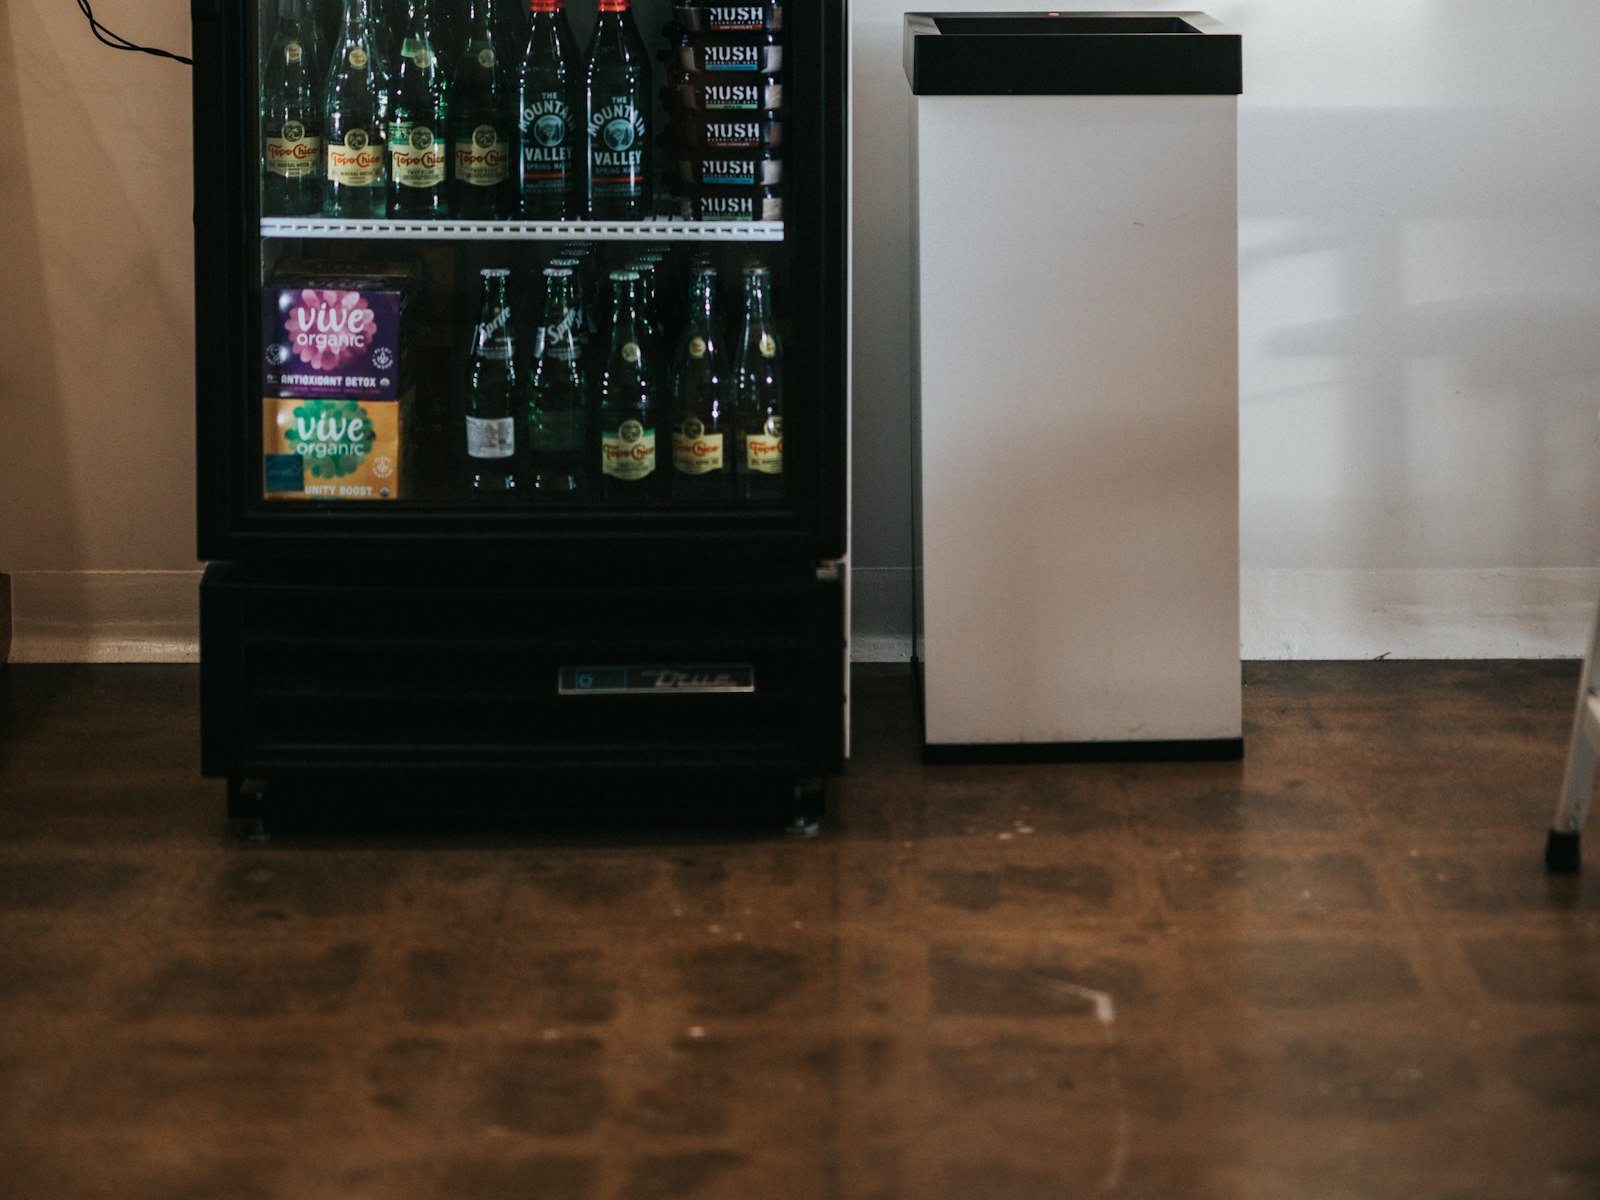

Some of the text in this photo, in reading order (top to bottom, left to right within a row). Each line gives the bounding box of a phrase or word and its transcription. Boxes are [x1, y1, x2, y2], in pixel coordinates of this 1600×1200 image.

[710, 7, 763, 21] MUSH
[705, 46, 758, 61] MUSH
[542, 92, 557, 100] THE
[612, 96, 628, 104] THE
[705, 85, 758, 100] MUSH
[587, 104, 646, 137] MOUNTAIN
[706, 123, 760, 138] MUSH
[269, 144, 318, 159] Topo Chico
[456, 150, 485, 166] Topo
[525, 147, 573, 161] VALLEY
[594, 151, 642, 166] VALLEY
[331, 152, 382, 168] Topo Chico
[393, 152, 446, 168] Topo Chico
[703, 160, 755, 175] MUSH
[701, 197, 753, 212] MUSH
[298, 302, 365, 334] vive
[297, 333, 365, 349] organic
[281, 374, 377, 388] ANTIOXIDANT DETOX
[298, 412, 365, 442] vive
[297, 442, 365, 458] organic
[305, 485, 373, 496] UNITY BOOST
